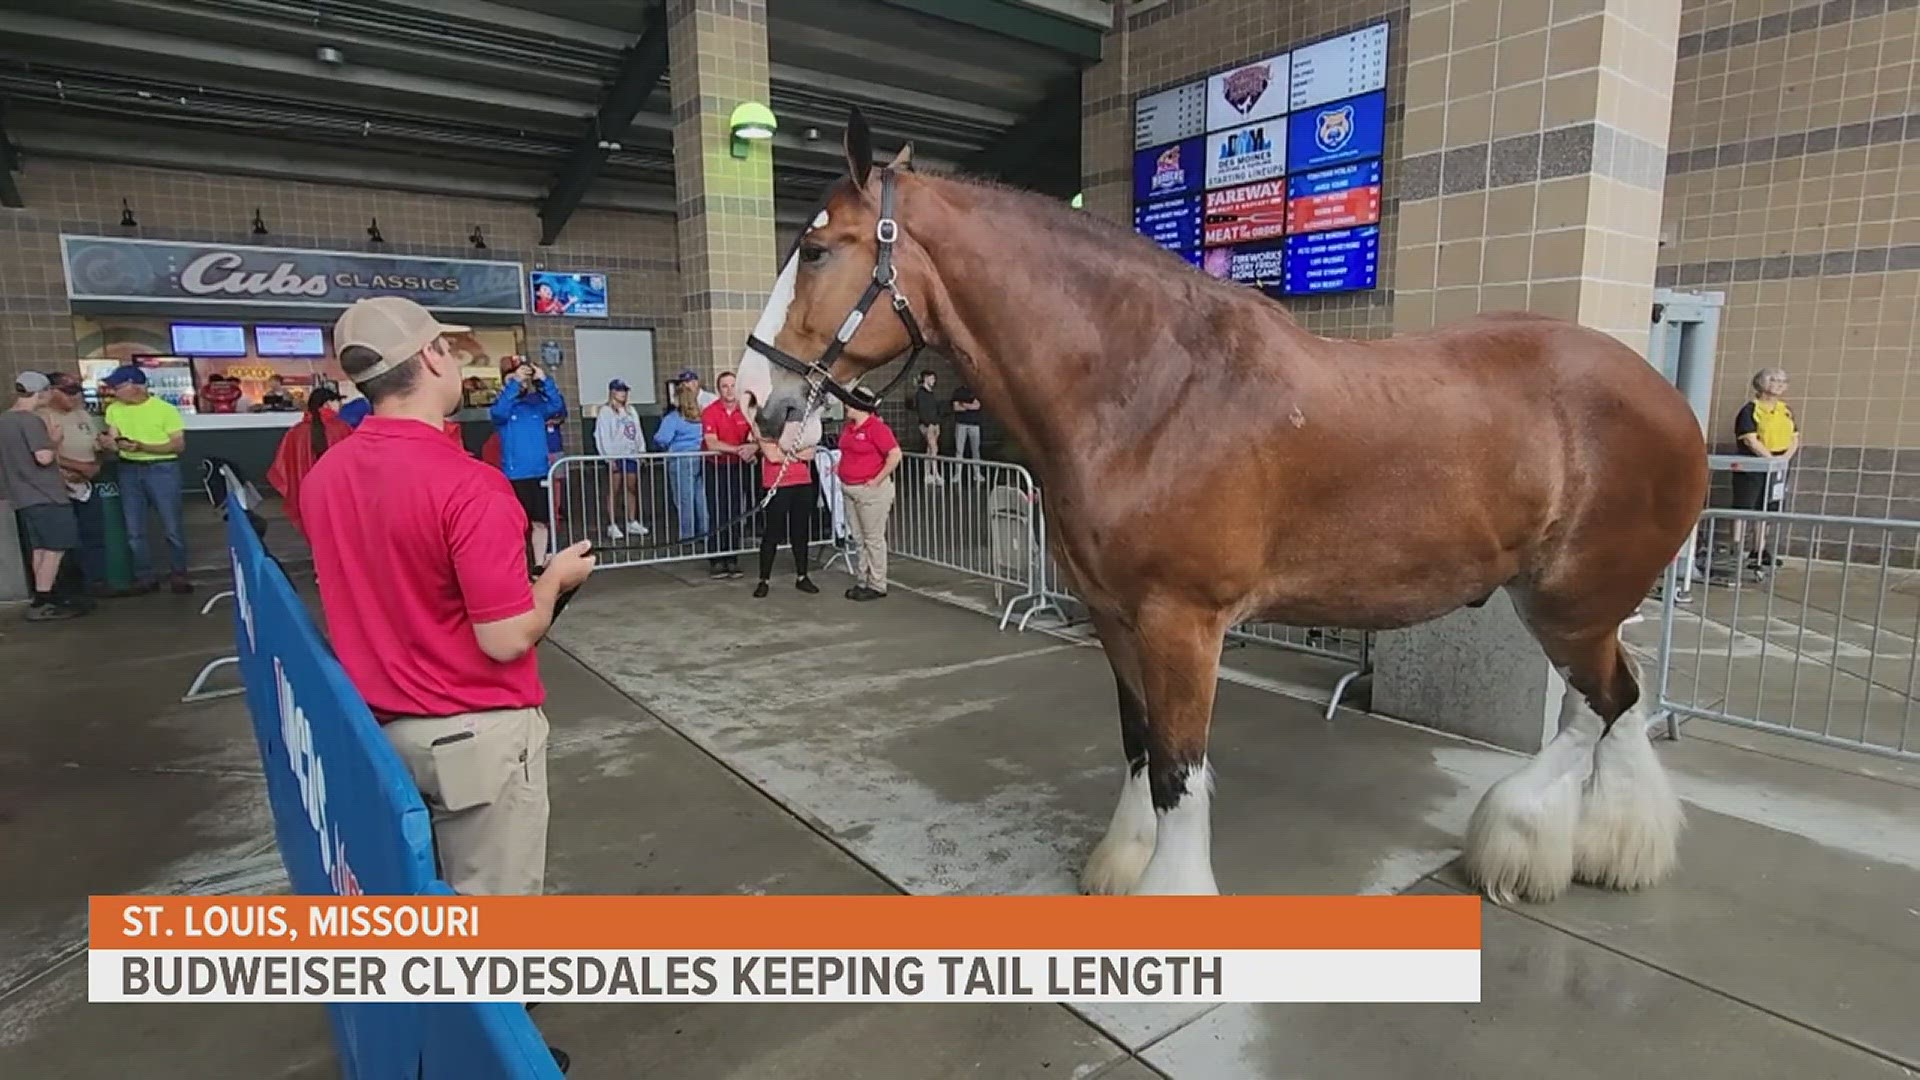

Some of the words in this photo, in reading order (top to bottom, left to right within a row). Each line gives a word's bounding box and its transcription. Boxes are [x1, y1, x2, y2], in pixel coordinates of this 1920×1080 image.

[1208, 171, 1246, 186] STARTING
[1248, 164, 1283, 179] LINEUPS
[1206, 180, 1283, 208] FAREWAY
[1206, 226, 1239, 242] MEAT
[1251, 224, 1282, 238] ORDER
[1233, 250, 1282, 263] FIREWORKS
[1255, 259, 1282, 270] FRIDAY
[181, 252, 328, 296] Cubs
[335, 273, 460, 292] CLASSICS
